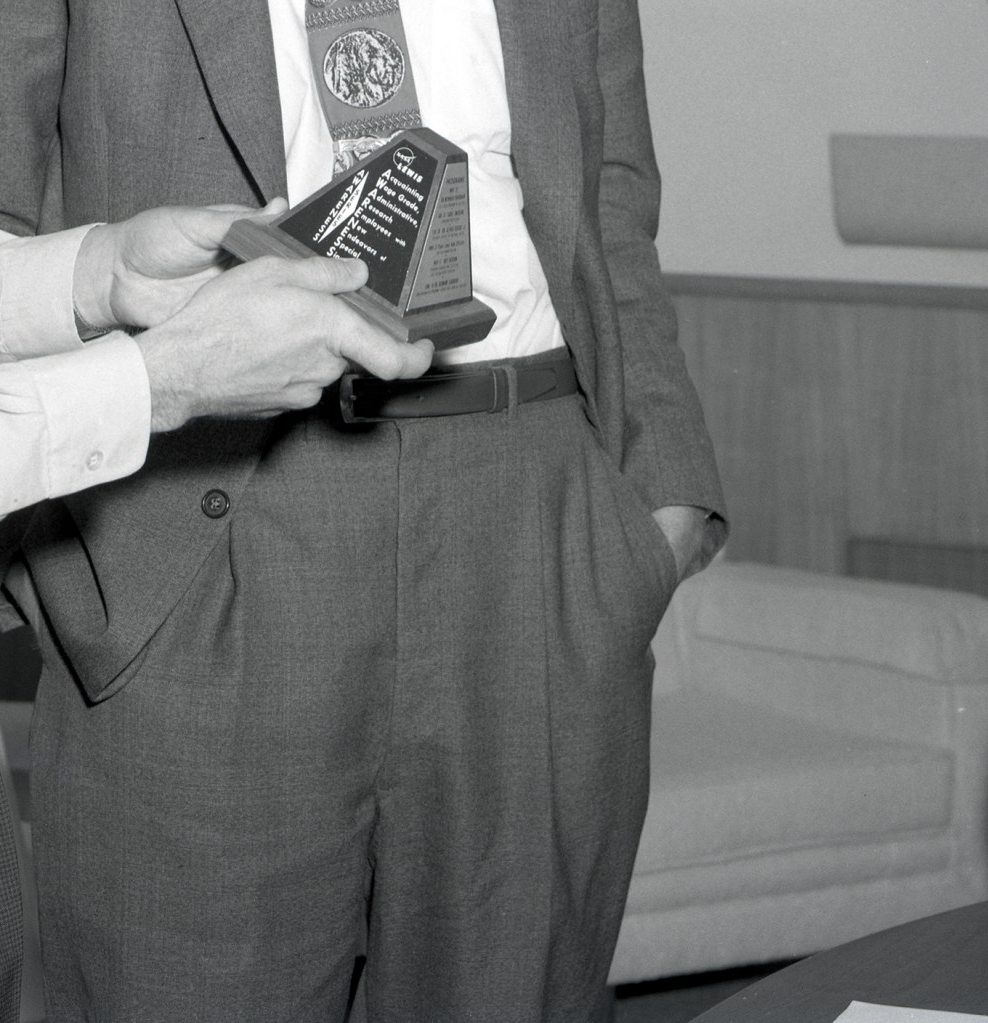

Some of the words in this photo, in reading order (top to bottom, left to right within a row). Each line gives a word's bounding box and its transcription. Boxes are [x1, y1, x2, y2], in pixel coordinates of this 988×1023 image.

[381, 169, 424, 202] Acquainting
[397, 162, 423, 183] LEWIS
[312, 169, 365, 241] AWARENESS
[332, 189, 361, 228] SERIES
[361, 197, 393, 224] Research
[367, 188, 419, 228] Administrative,
[375, 176, 396, 197] Wage
[398, 194, 420, 214] Grade,
[340, 226, 378, 255] Endeavors
[347, 216, 367, 235] New
[353, 206, 392, 237] Employees
[394, 237, 406, 247] with
[333, 236, 362, 259] Special
